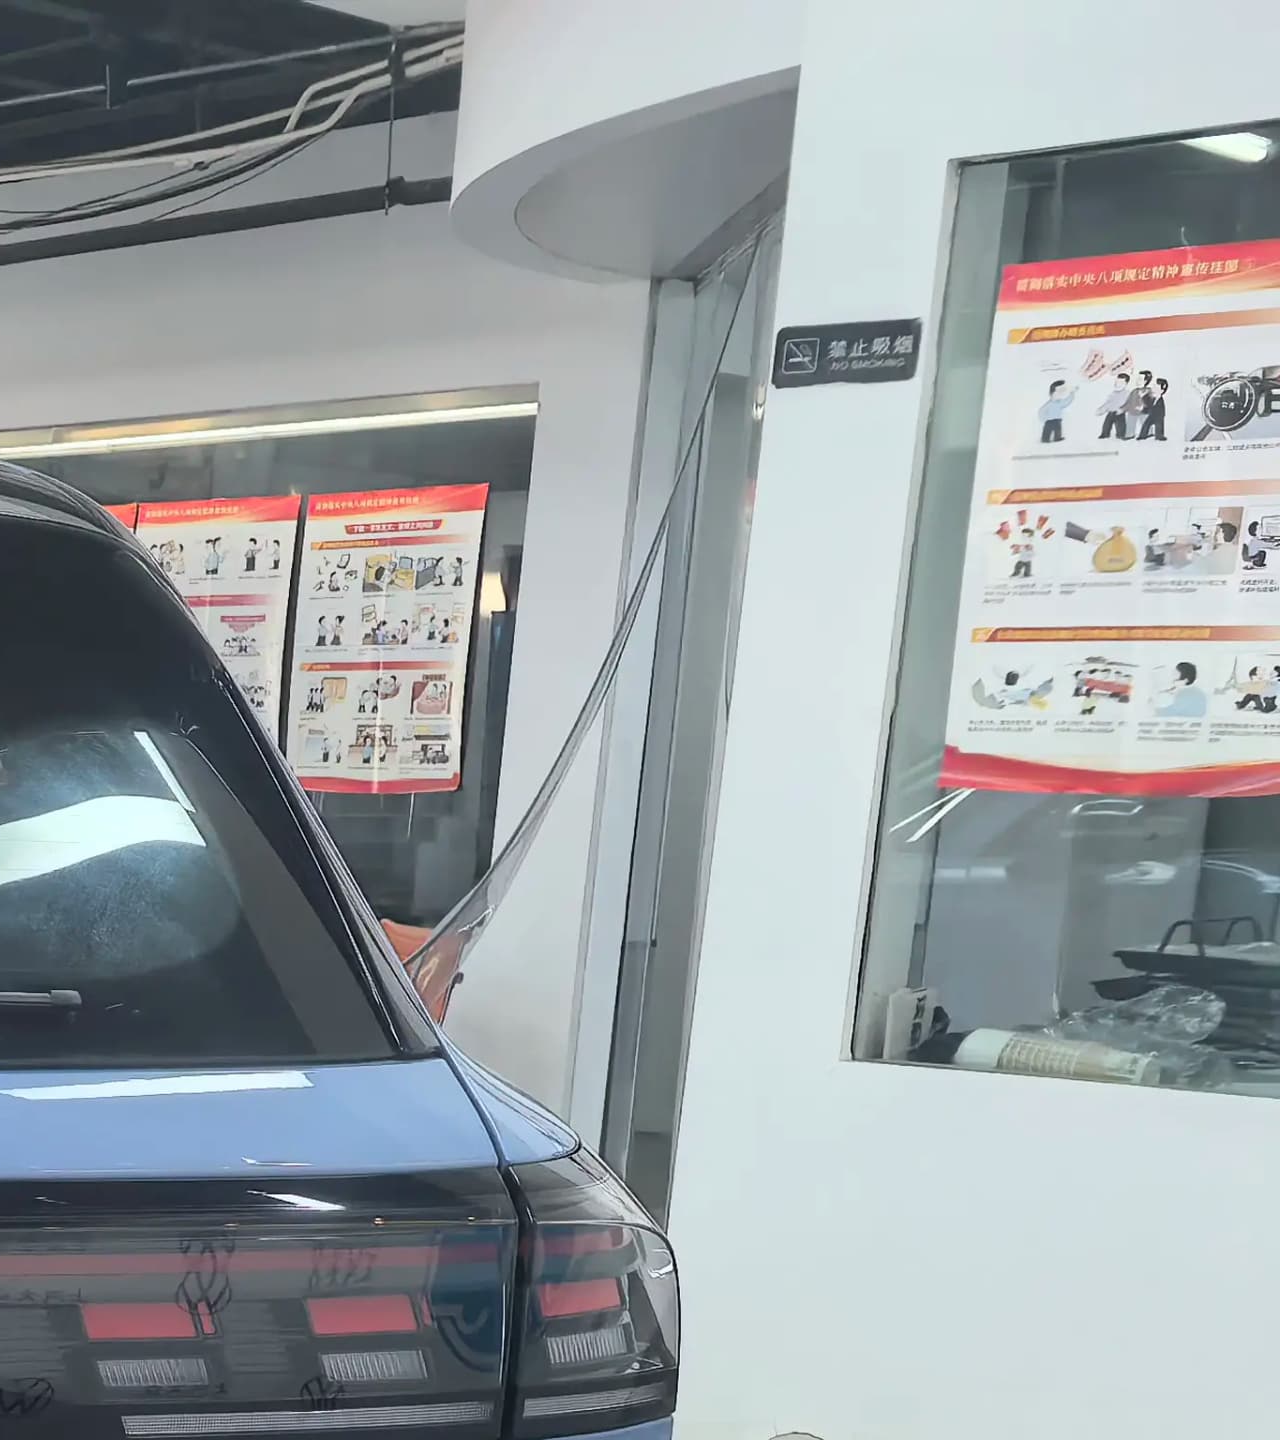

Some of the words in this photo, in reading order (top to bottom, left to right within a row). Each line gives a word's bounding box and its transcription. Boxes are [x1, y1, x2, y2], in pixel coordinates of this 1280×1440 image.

[827, 334, 914, 359] 禁止吸烟
[829, 361, 849, 371] NO
